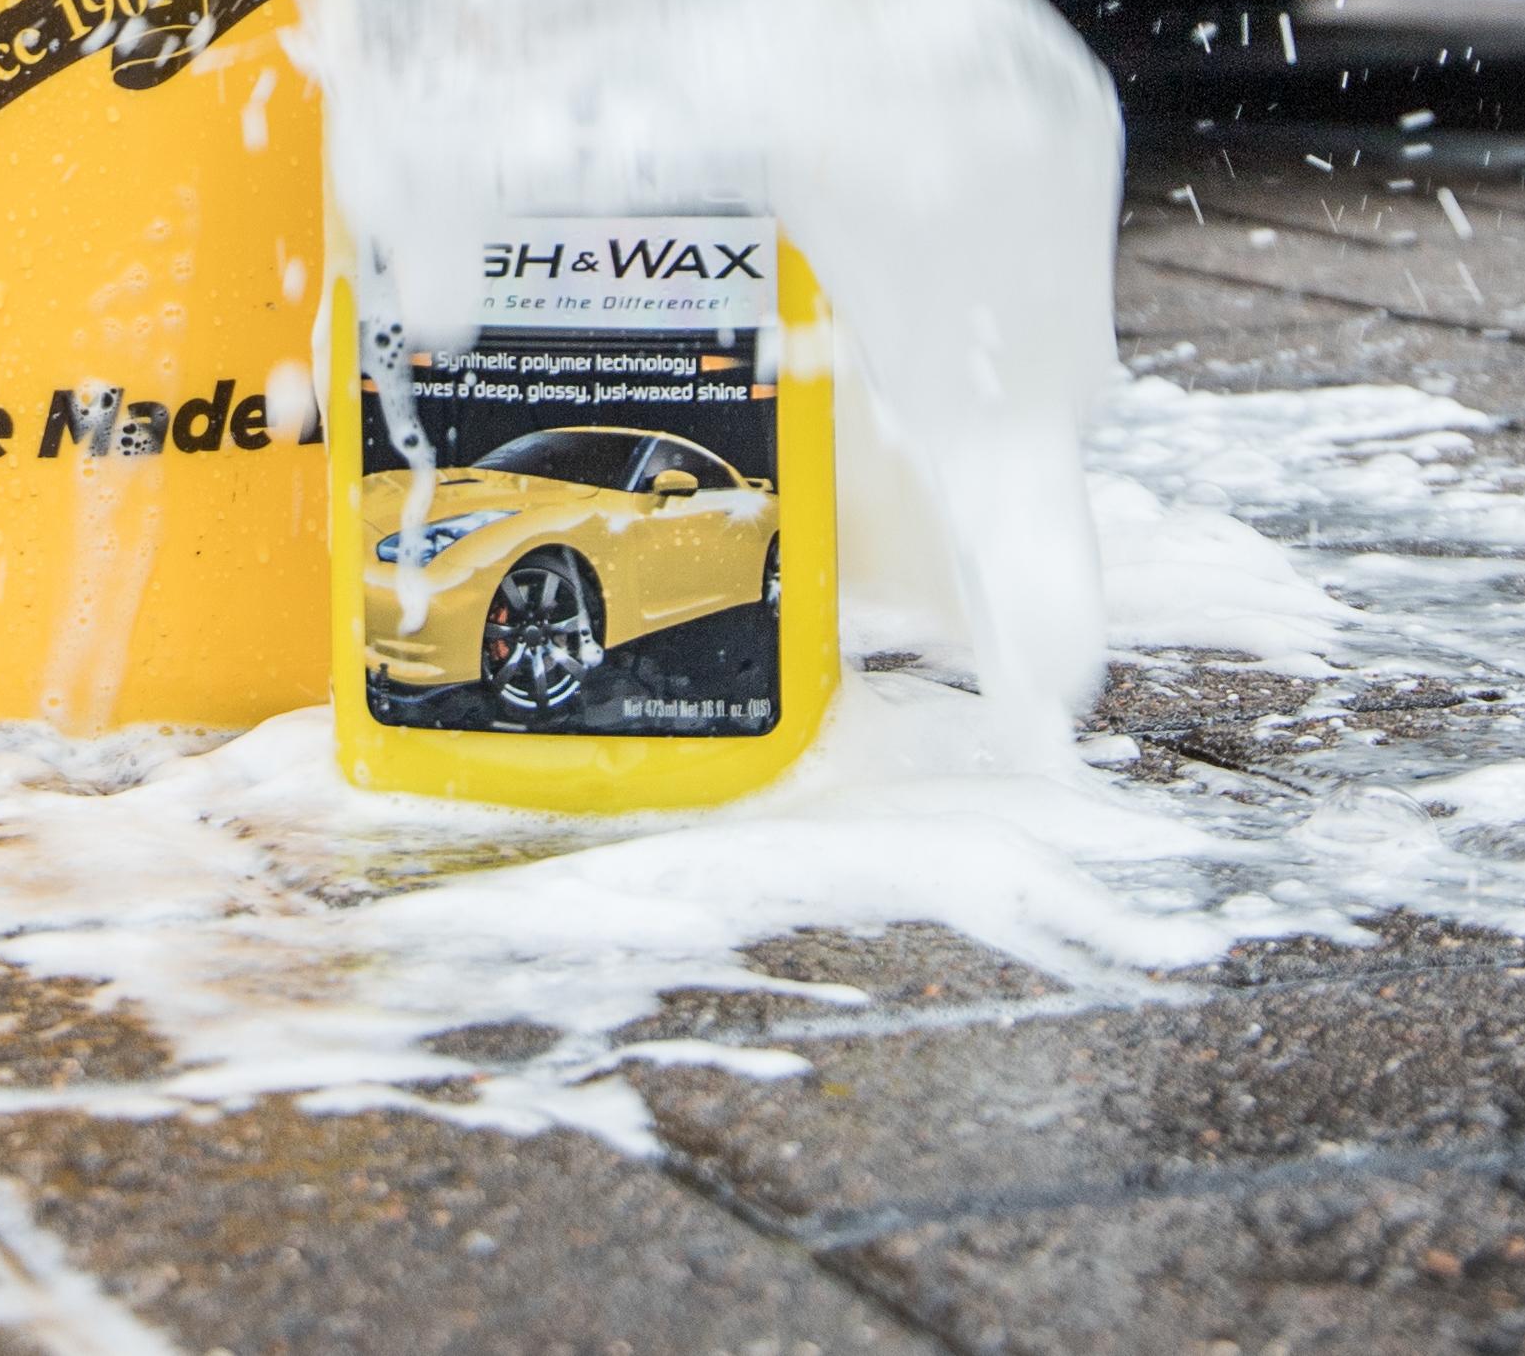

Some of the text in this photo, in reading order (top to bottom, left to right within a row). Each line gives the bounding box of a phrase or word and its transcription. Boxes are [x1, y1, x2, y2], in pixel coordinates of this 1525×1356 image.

[483, 238, 765, 280] SH & WAX
[506, 294, 546, 310] See
[557, 294, 592, 310] the
[603, 294, 731, 311] Difference!
[437, 351, 697, 376] Synthetic polymer technology
[413, 382, 454, 399] aves
[527, 381, 591, 403] glossy,
[593, 382, 694, 404] just-waxed
[697, 382, 748, 401] shine
[37, 379, 274, 459] Made
